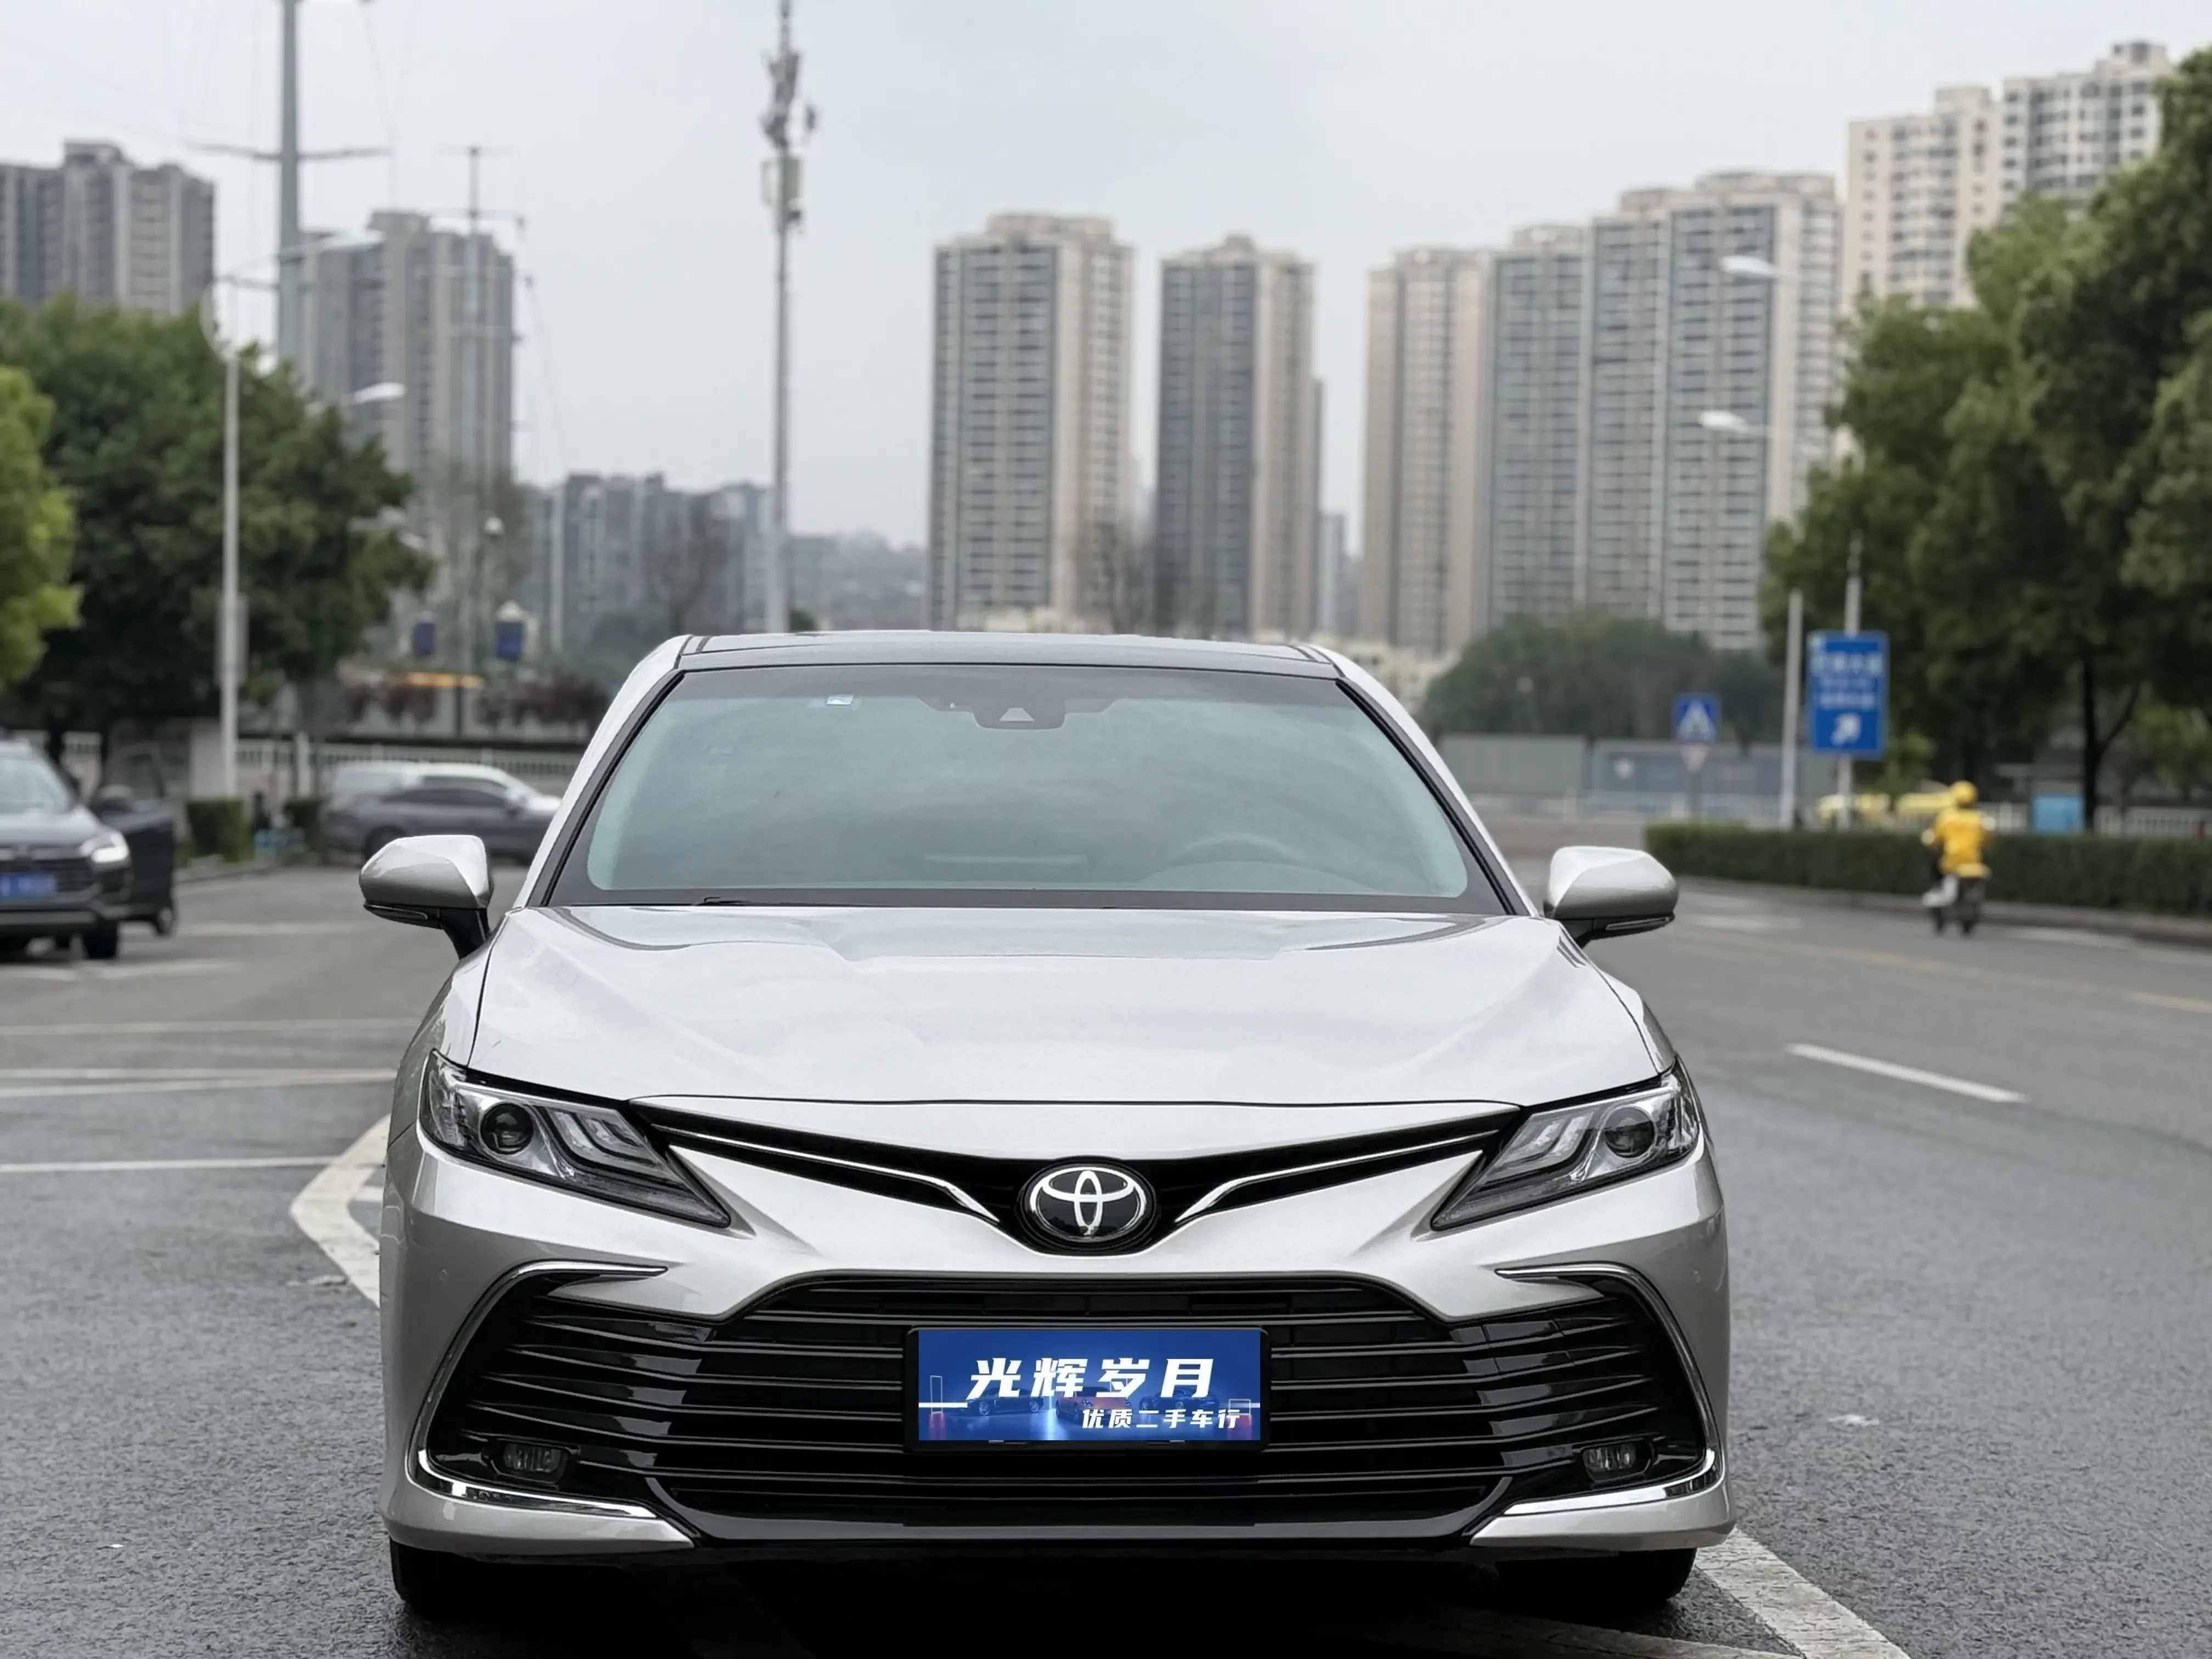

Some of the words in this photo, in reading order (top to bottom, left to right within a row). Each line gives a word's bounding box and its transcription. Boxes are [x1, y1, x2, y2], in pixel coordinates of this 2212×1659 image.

[967, 1358, 1214, 1400] 光辉岁月
[1082, 1409, 1241, 1429] 优质二手车行
